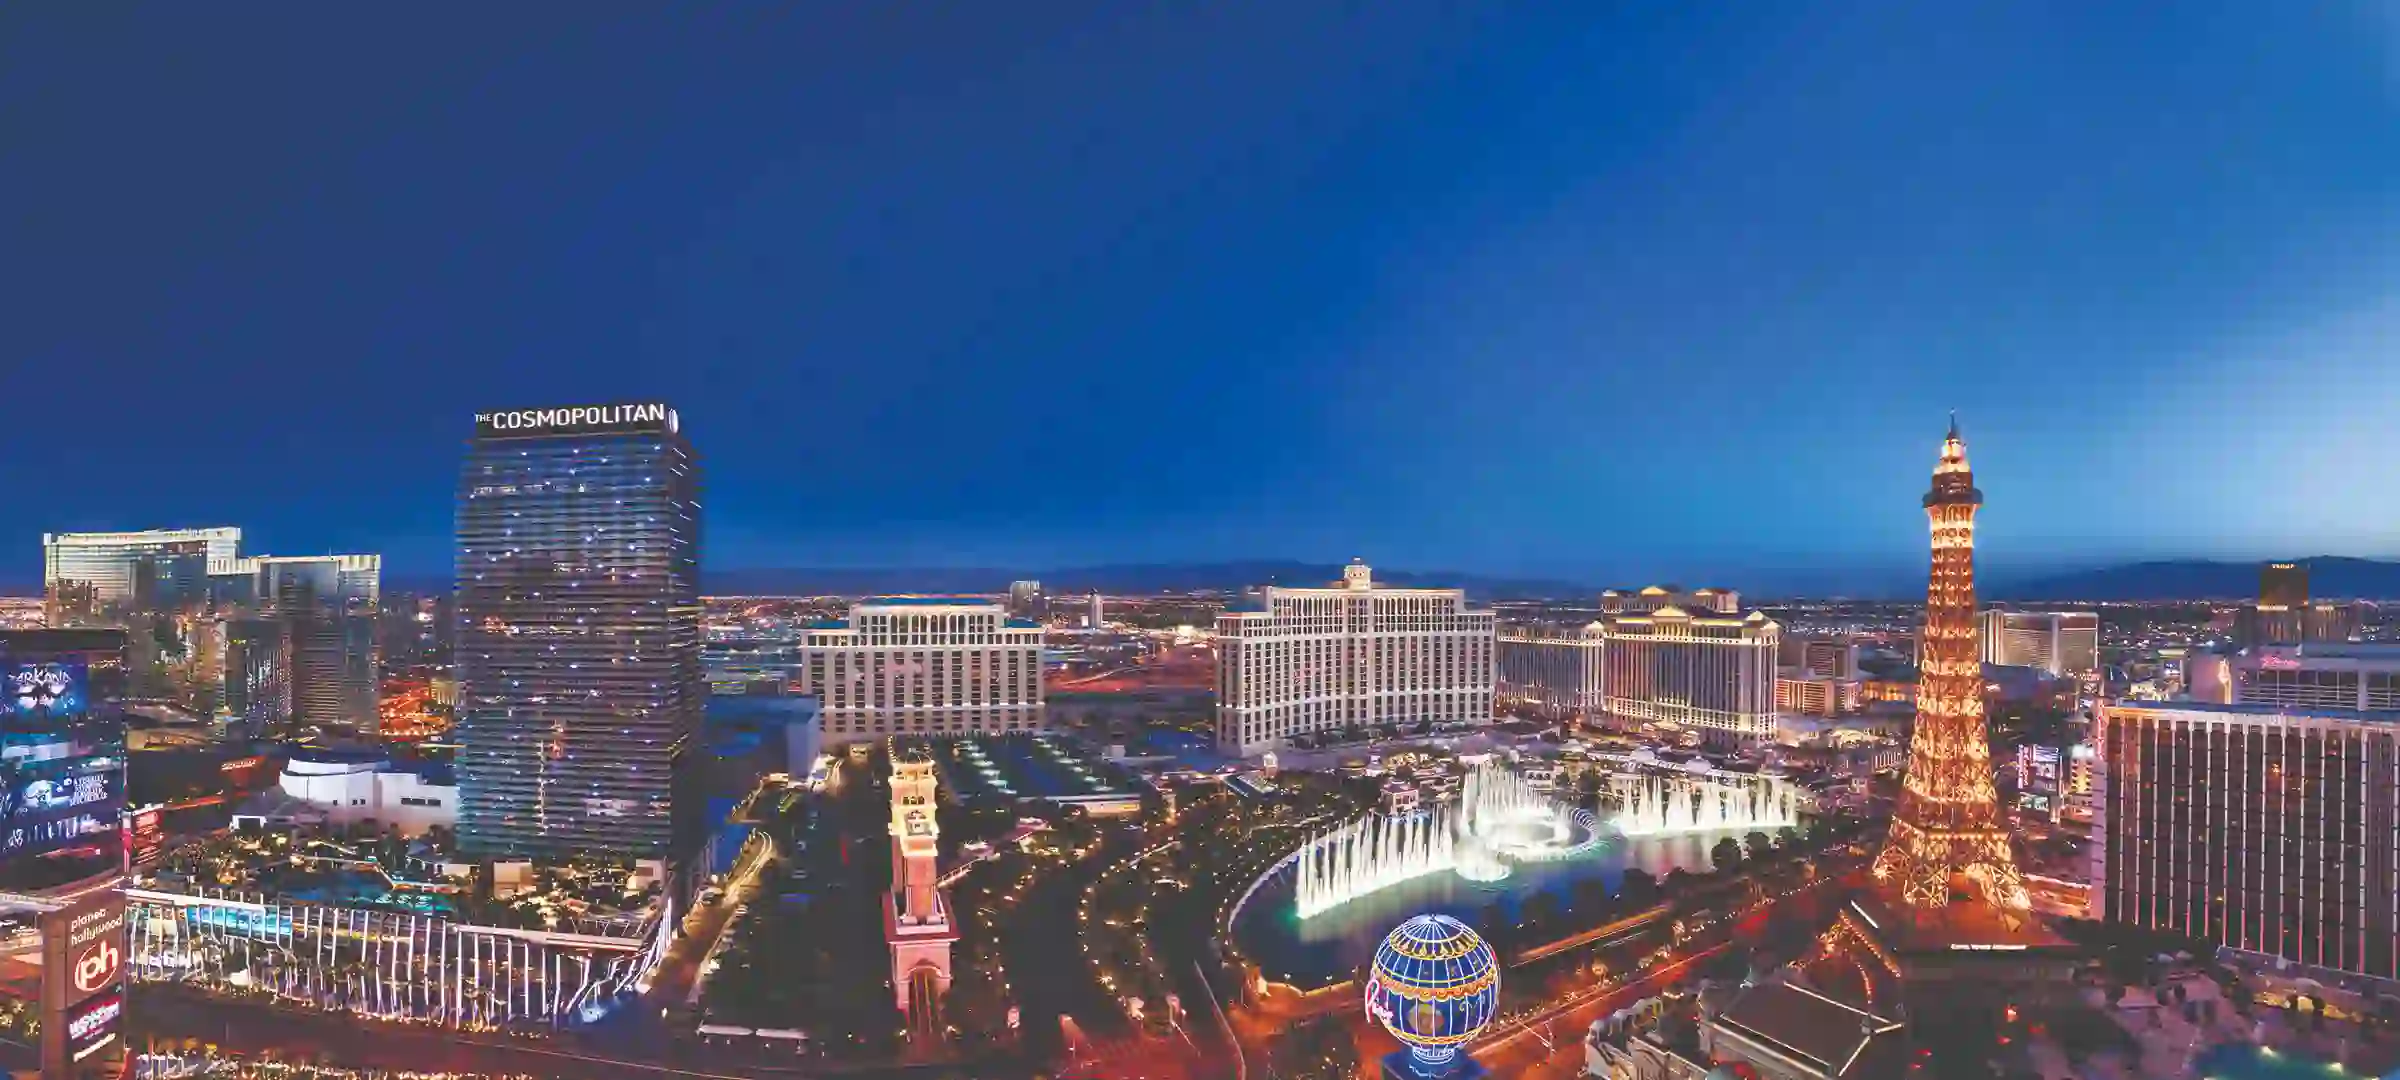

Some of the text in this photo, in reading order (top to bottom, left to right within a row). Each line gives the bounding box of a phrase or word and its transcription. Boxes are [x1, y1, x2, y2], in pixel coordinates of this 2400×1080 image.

[475, 403, 665, 429] THE COSMOPOLITAN
[71, 909, 106, 932] planet
[71, 913, 123, 946] hollywood
[80, 940, 118, 987] ph
